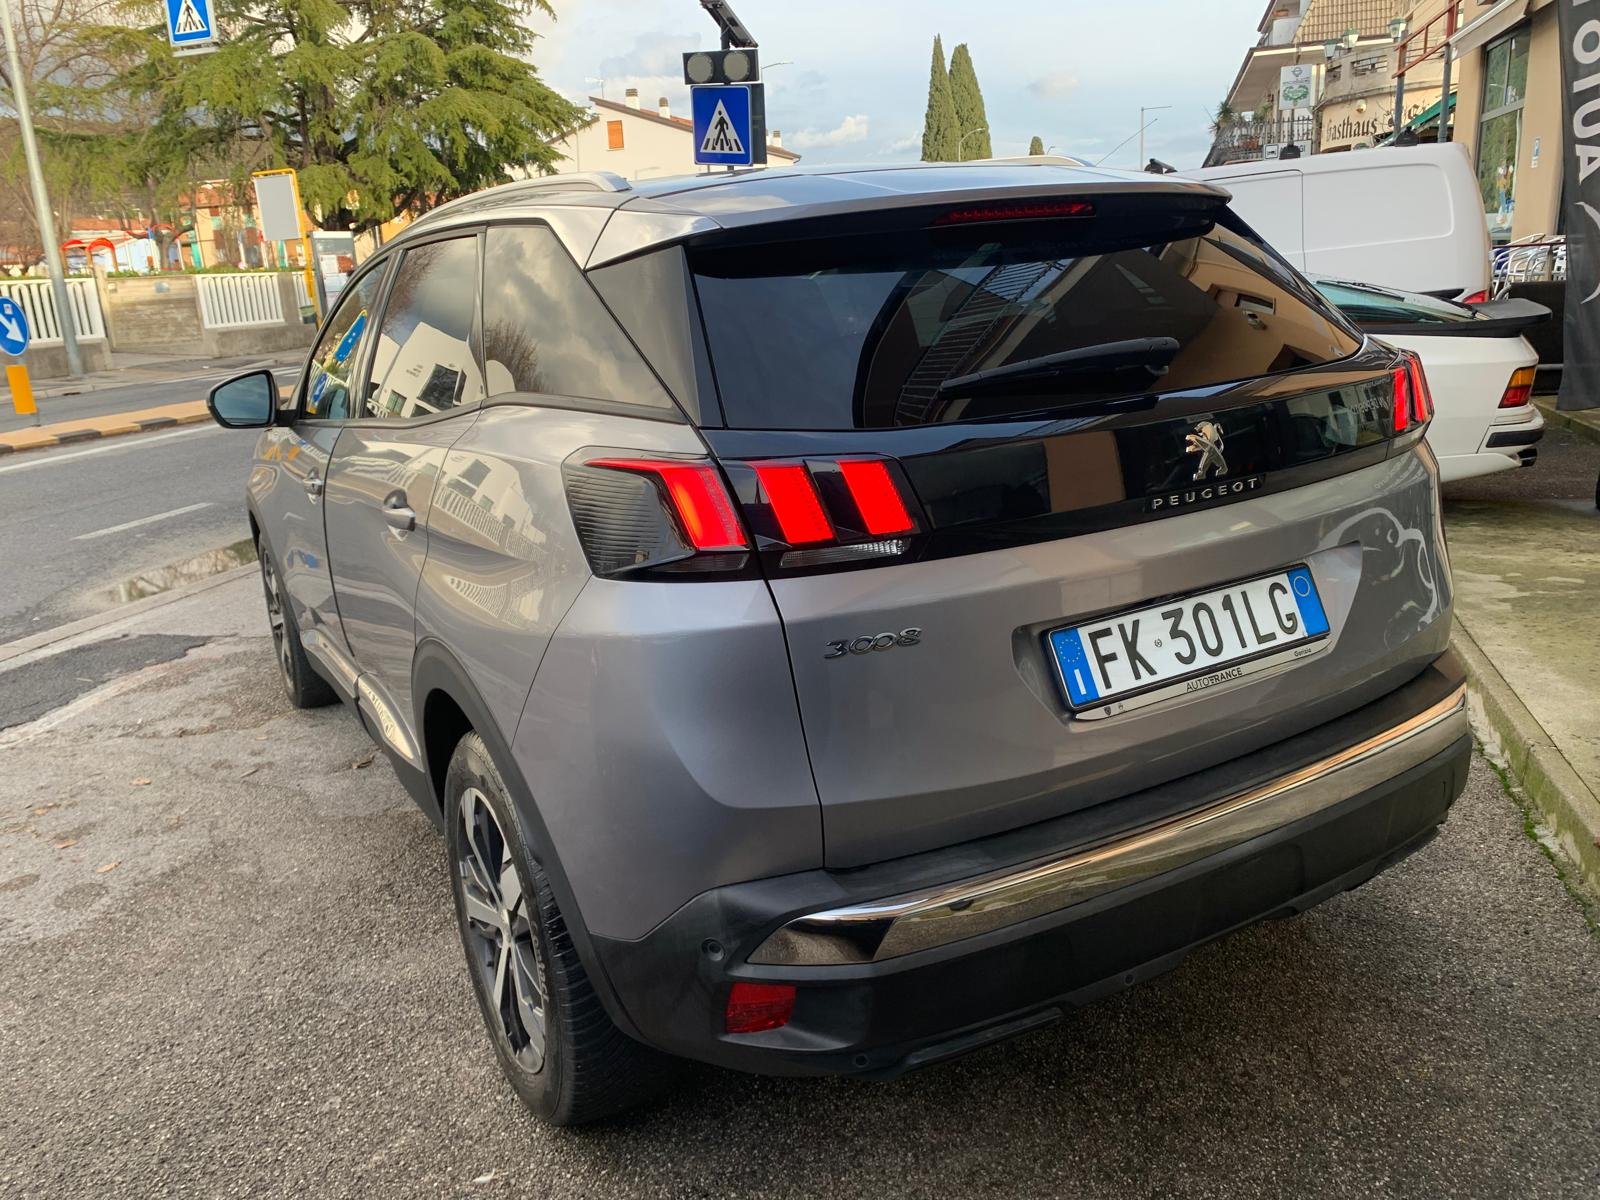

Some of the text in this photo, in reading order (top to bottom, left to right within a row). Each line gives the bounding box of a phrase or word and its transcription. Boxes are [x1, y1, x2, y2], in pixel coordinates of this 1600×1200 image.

[1152, 477, 1259, 510] PEUGEOT
[823, 627, 922, 660] 3008
[1087, 581, 1299, 690] FK 301LG
[1186, 666, 1244, 693] AUTOFRANCE
